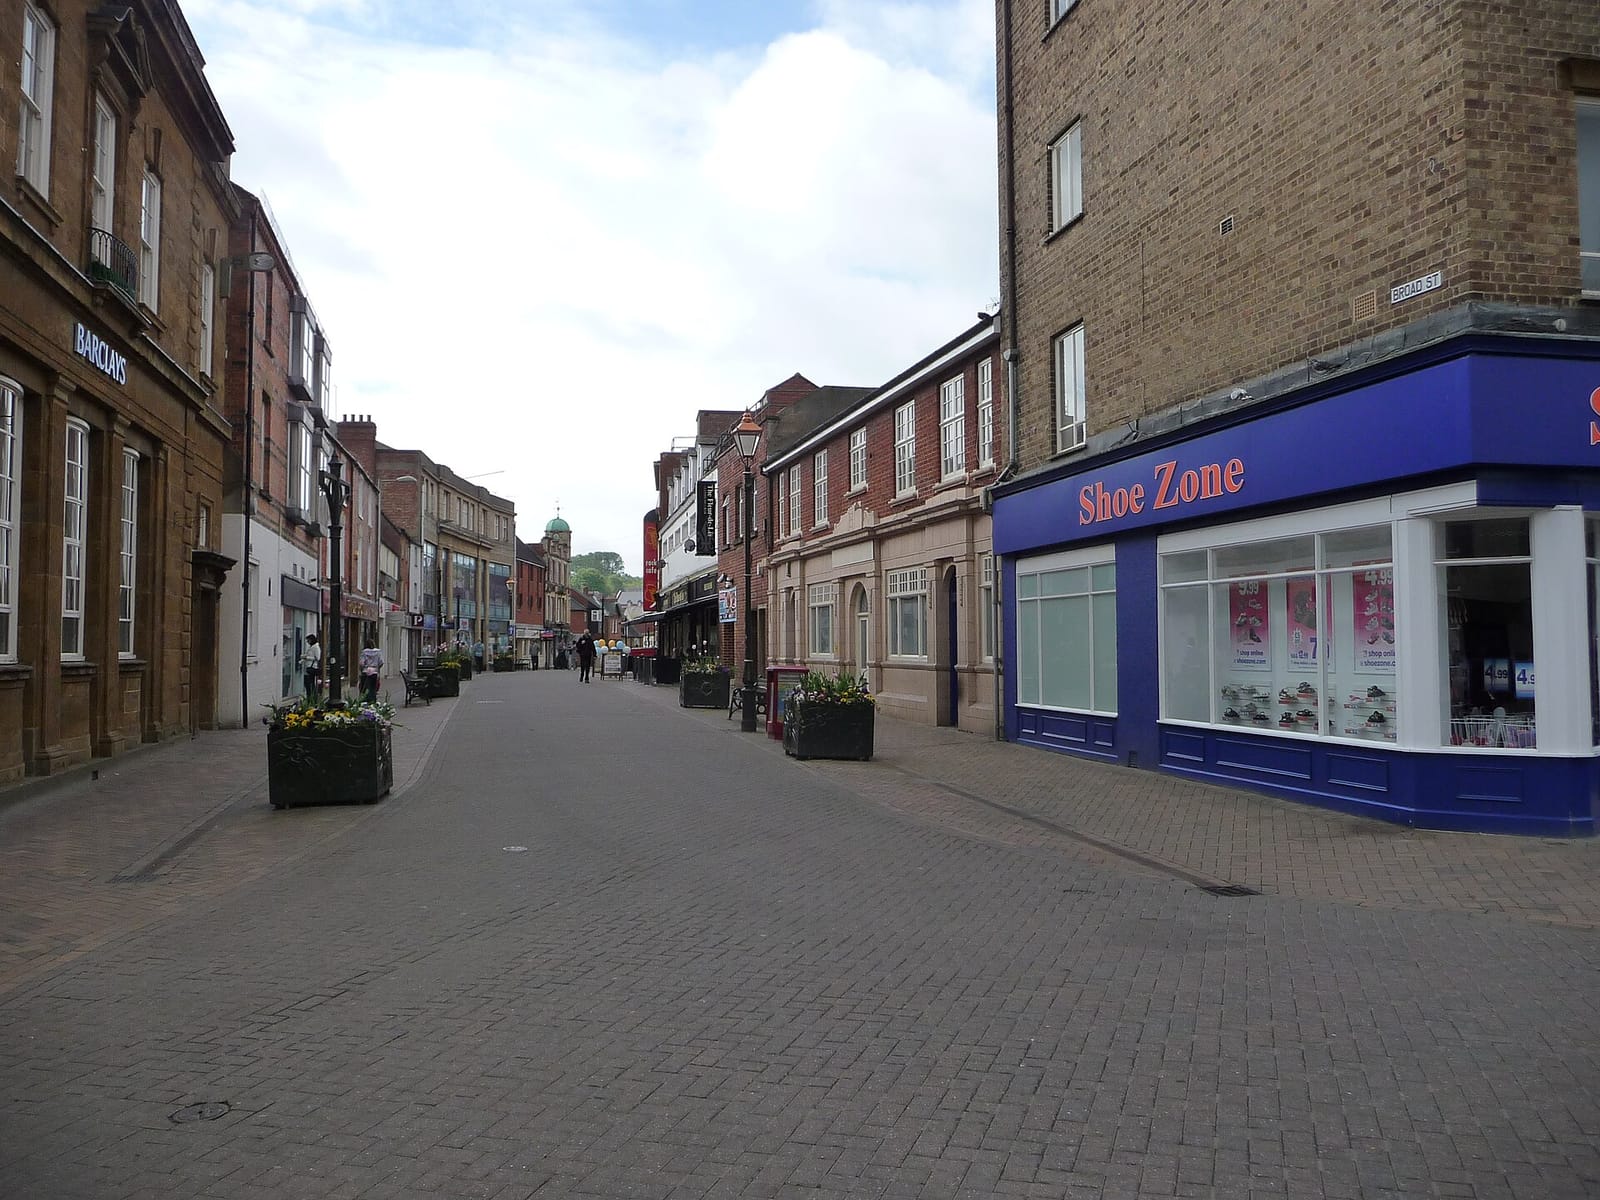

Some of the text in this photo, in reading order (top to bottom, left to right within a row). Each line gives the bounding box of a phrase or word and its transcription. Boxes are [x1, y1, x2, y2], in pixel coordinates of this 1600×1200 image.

[1393, 274, 1439, 301] BROAD ST
[76, 322, 127, 385] BARCLAYS
[1079, 458, 1245, 526] Shoe Zone
[1368, 650, 1382, 658] shop
